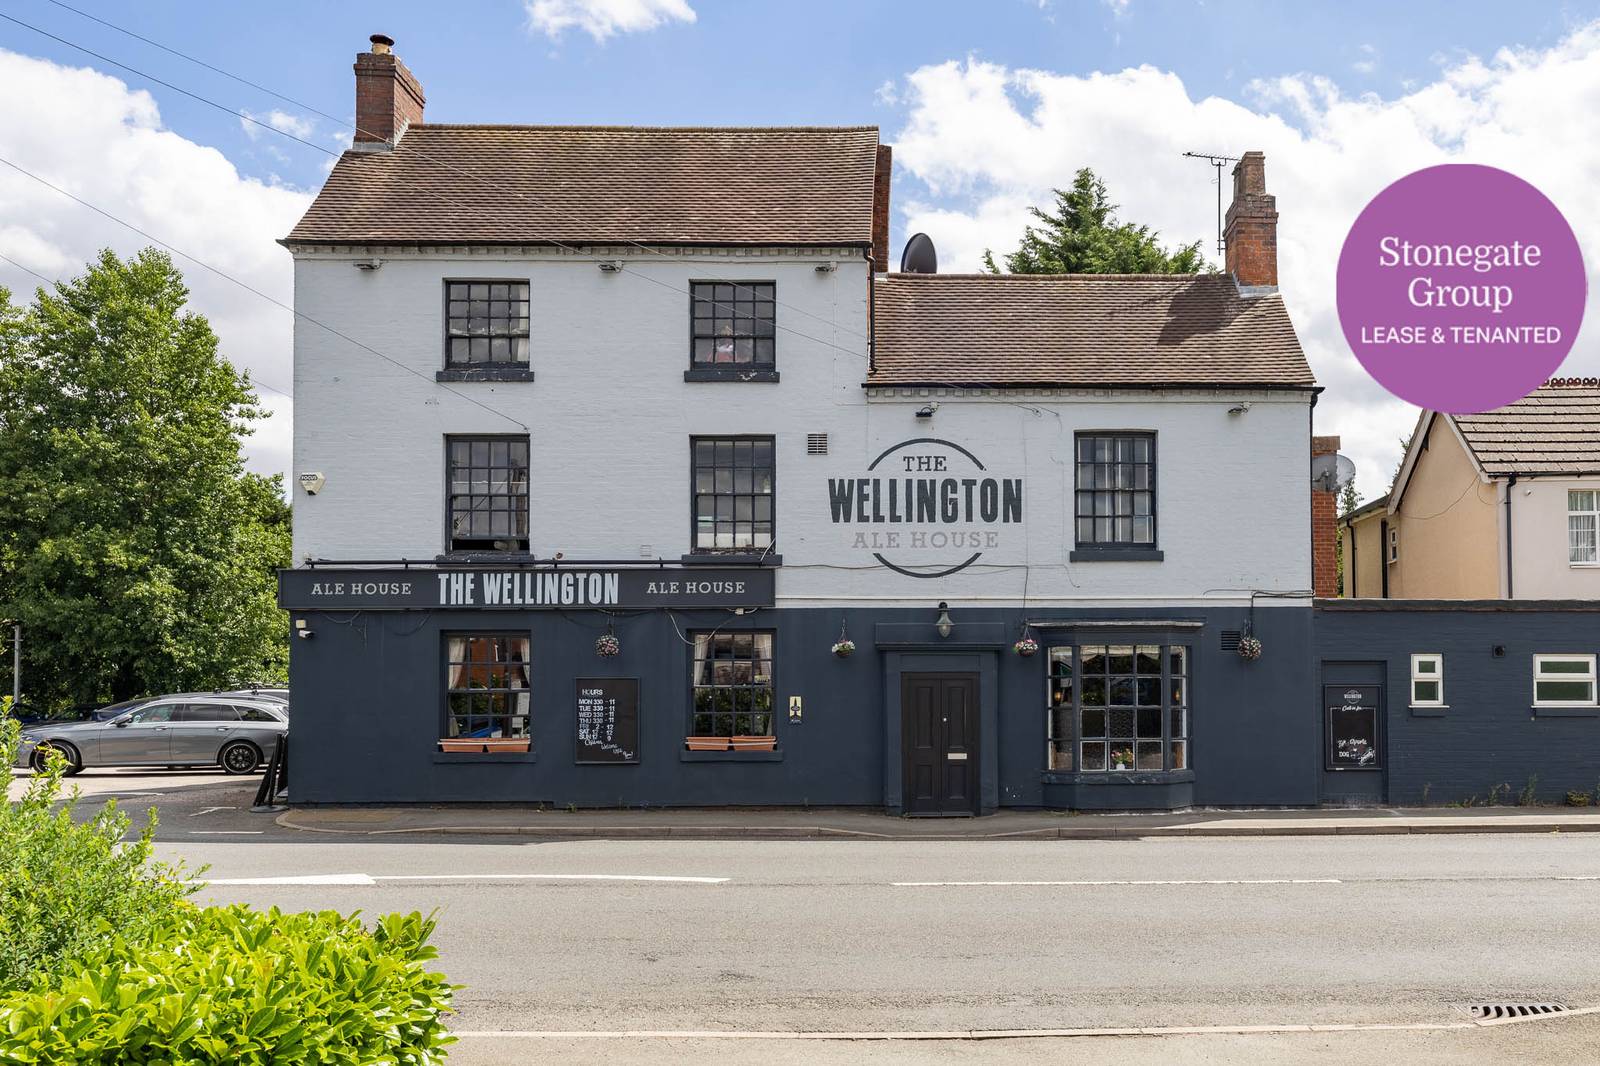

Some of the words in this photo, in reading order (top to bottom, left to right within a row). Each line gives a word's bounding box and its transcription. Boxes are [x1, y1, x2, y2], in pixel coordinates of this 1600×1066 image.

[903, 455, 947, 472] THE
[828, 478, 1022, 524] WELLINGTON
[852, 531, 900, 549] ALE
[910, 531, 999, 549] HOUSE
[311, 583, 344, 595] ALE
[351, 583, 412, 595] HOUSE
[438, 573, 474, 604] THE
[483, 573, 619, 604] WELLINGTON
[646, 582, 679, 594] ALE
[685, 582, 746, 594] HOUSE
